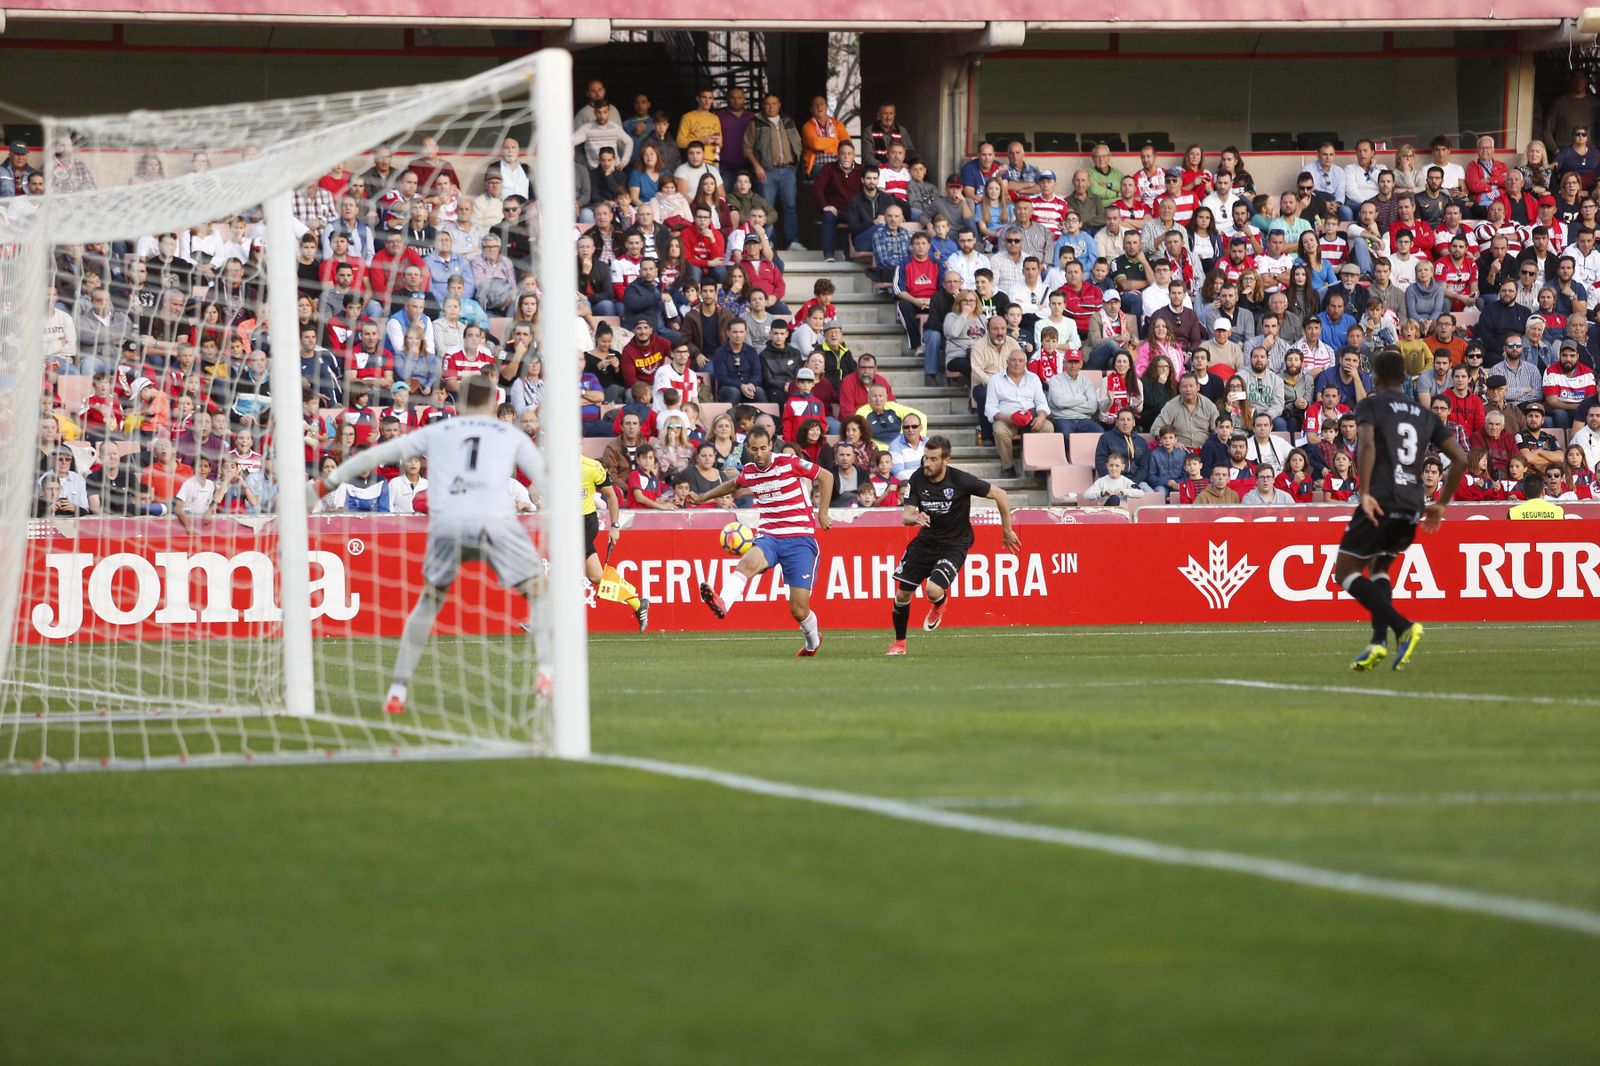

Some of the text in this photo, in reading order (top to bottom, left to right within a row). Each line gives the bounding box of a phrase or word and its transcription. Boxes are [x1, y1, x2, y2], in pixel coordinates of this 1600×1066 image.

[461, 436, 481, 472] 1
[1397, 422, 1418, 465] 3
[1521, 511, 1555, 519] SEGURIDAD
[826, 552, 1048, 600] ALHBRA
[1051, 553, 1078, 574] SIN
[1268, 543, 1446, 602] CAA
